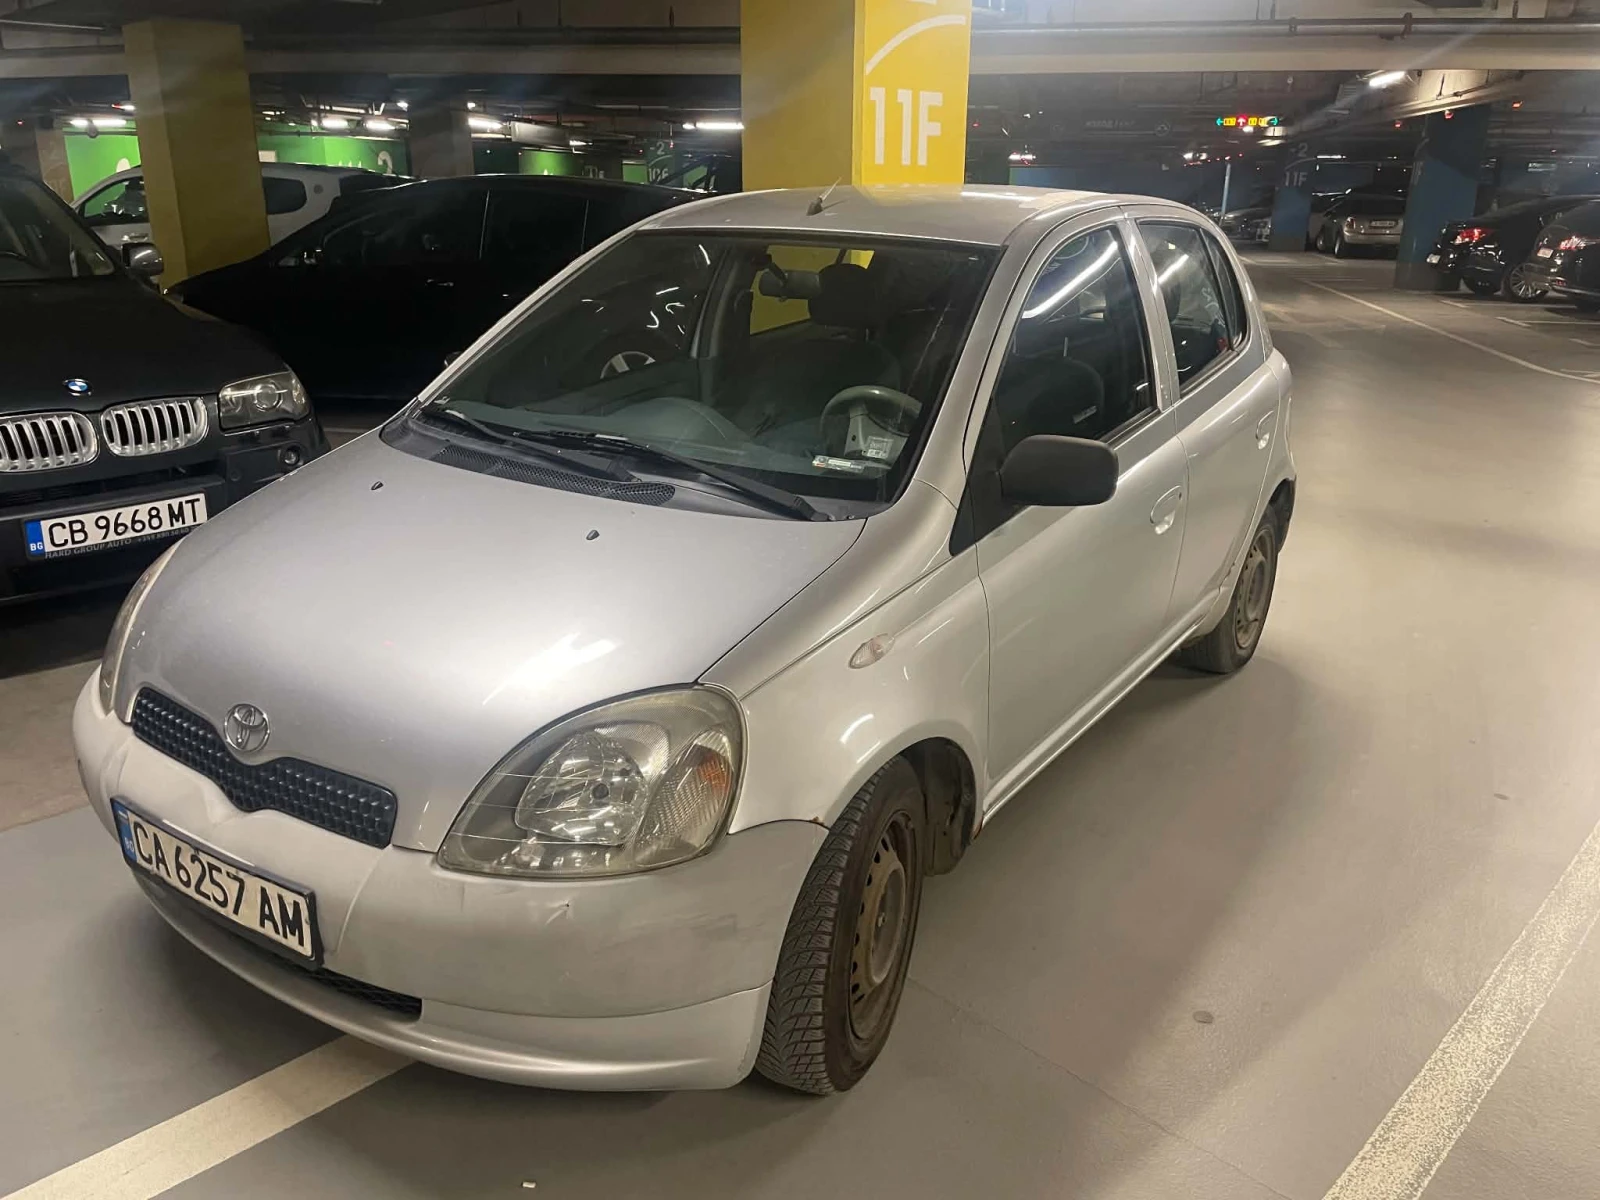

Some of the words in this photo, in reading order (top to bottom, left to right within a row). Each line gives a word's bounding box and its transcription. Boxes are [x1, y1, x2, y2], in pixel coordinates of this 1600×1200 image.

[869, 86, 944, 166] 11F
[1284, 171, 1308, 187] 11F
[48, 519, 89, 548] CB
[94, 506, 163, 540] 9668
[167, 498, 201, 527] MT
[30, 542, 44, 551] BG
[45, 549, 72, 559] HARD
[107, 537, 132, 549] AUTO
[133, 821, 172, 879] CA
[174, 845, 245, 916] 6257
[259, 885, 305, 948] AM
